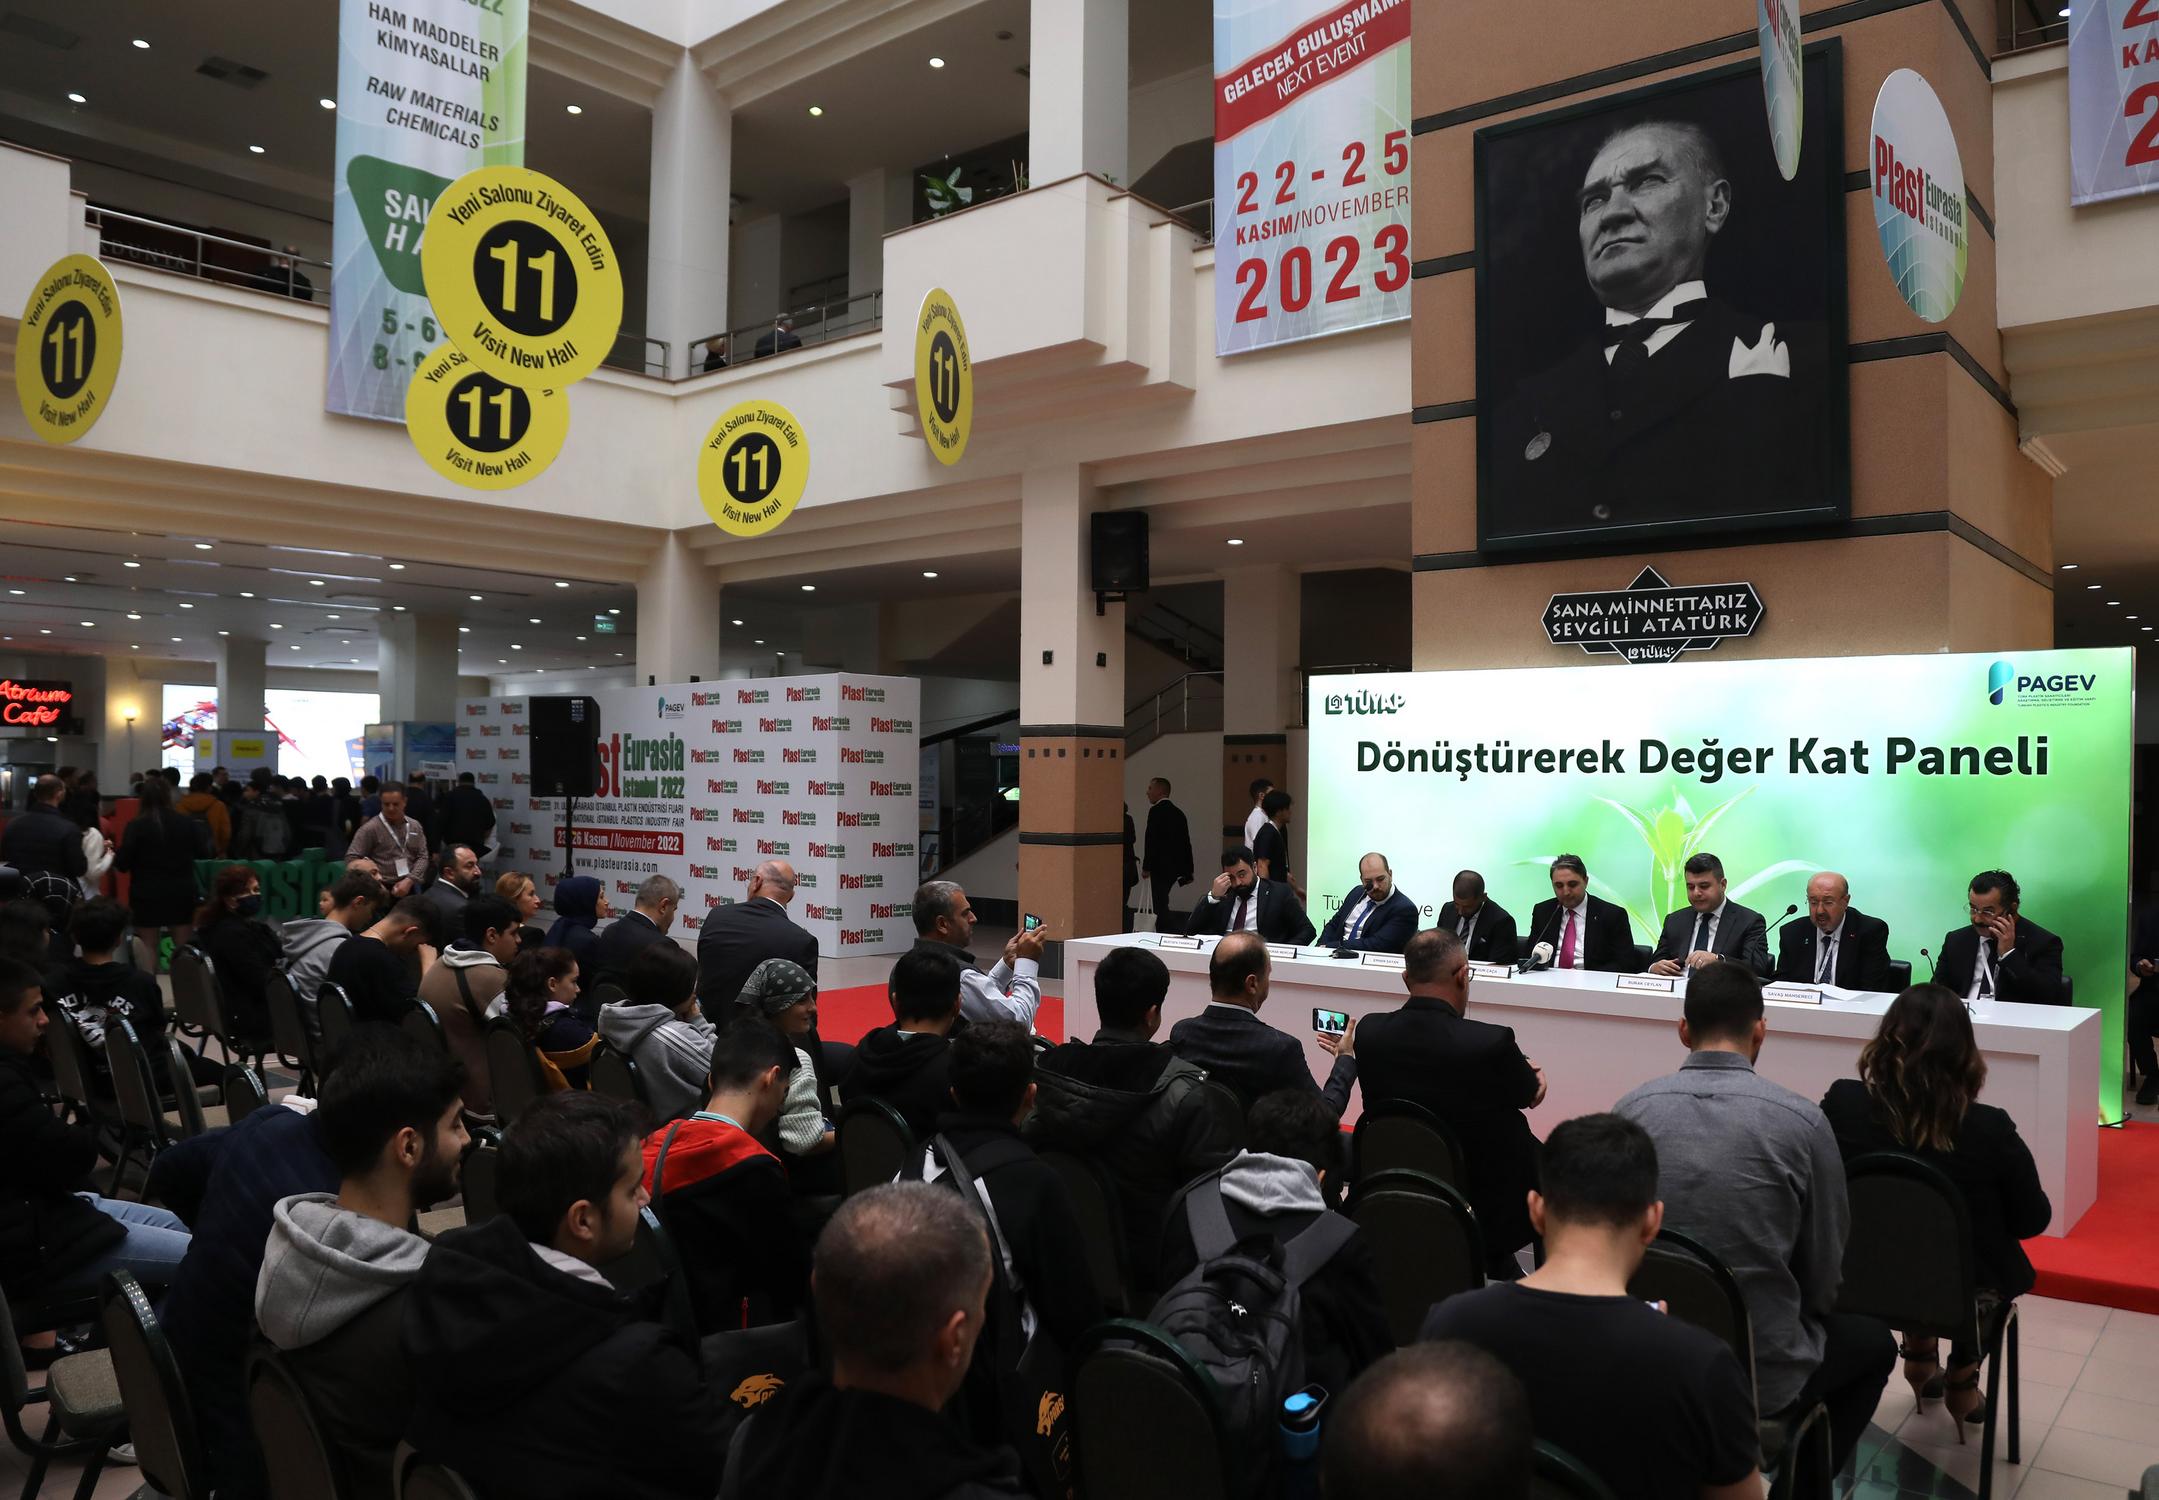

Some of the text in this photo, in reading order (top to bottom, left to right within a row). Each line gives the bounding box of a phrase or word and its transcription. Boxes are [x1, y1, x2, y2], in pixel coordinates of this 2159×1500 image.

[369, 2, 498, 62] HAM MADDELER
[377, 29, 489, 82] KİMYASALLAR
[1224, 0, 1403, 104] GELECEK BULUŞMA
[1276, 31, 1366, 99] NEXT EVENT
[366, 76, 499, 131] RAW MATERIALS
[386, 108, 480, 149] CHEMICALS
[1875, 134, 1961, 228] Plast Eurasia
[447, 183, 605, 272] Yeni Salonu Ziyaret Edin
[490, 240, 555, 321] 11
[1236, 224, 1410, 323] 2023
[28, 298, 45, 327] Yeni
[49, 317, 84, 383] 11
[473, 322, 578, 369] Visit New Hall
[424, 359, 451, 384] Yeni
[934, 346, 953, 411] 11
[40, 390, 96, 426] Visit New Hall
[458, 386, 512, 439] 11
[709, 410, 798, 450] Yeni Salonu Ziyaret Edin
[446, 448, 531, 476] Visit New Hall
[731, 445, 768, 491] 11
[722, 498, 782, 523] Visit New Hall
[1553, 593, 1747, 618] SANA MİNNETTARIZ
[1553, 612, 1747, 636] SEVGİLİ ATATÜRK
[2018, 674, 2096, 692] PAGEV
[0, 680, 72, 702] Atrium
[738, 690, 754, 703] Plast
[787, 688, 804, 701] Plast
[842, 685, 864, 701] Plast
[692, 692, 707, 706] Plast
[4, 703, 60, 725] Cafe
[665, 704, 684, 712] PAGEV
[712, 720, 727, 733] Plast
[760, 718, 776, 732] Plast
[813, 716, 831, 731] Plast
[871, 718, 893, 732] Plast
[623, 732, 684, 771] Eurasia
[691, 749, 705, 762] Plast
[734, 749, 749, 762] Plast
[783, 748, 800, 762] Plast
[841, 748, 864, 763] Plast
[1357, 736, 2048, 783] Dönüştürerek Değer Kat Paneli
[661, 777, 684, 798] 2022
[708, 779, 723, 793] Plast
[757, 780, 774, 794] Plast
[808, 781, 826, 795] Plast
[871, 781, 892, 796] Plast
[691, 808, 705, 821] Plast
[733, 809, 749, 823] Plast
[783, 810, 800, 825] Plast
[837, 812, 860, 826] Plast
[658, 836, 679, 850] 2022
[707, 836, 722, 851] Plast
[758, 839, 774, 854] Plast
[809, 842, 827, 858] Plast
[873, 843, 895, 857] Plast
[576, 857, 658, 872] www.plasteurasia.com
[690, 864, 704, 878] Plast
[734, 867, 750, 881] Plast
[840, 874, 863, 889] Plast
[705, 894, 720, 907] Plast
[806, 904, 824, 919] Plast
[871, 904, 893, 918] Plast
[683, 915, 697, 929] Plast
[841, 929, 863, 944] Plast
